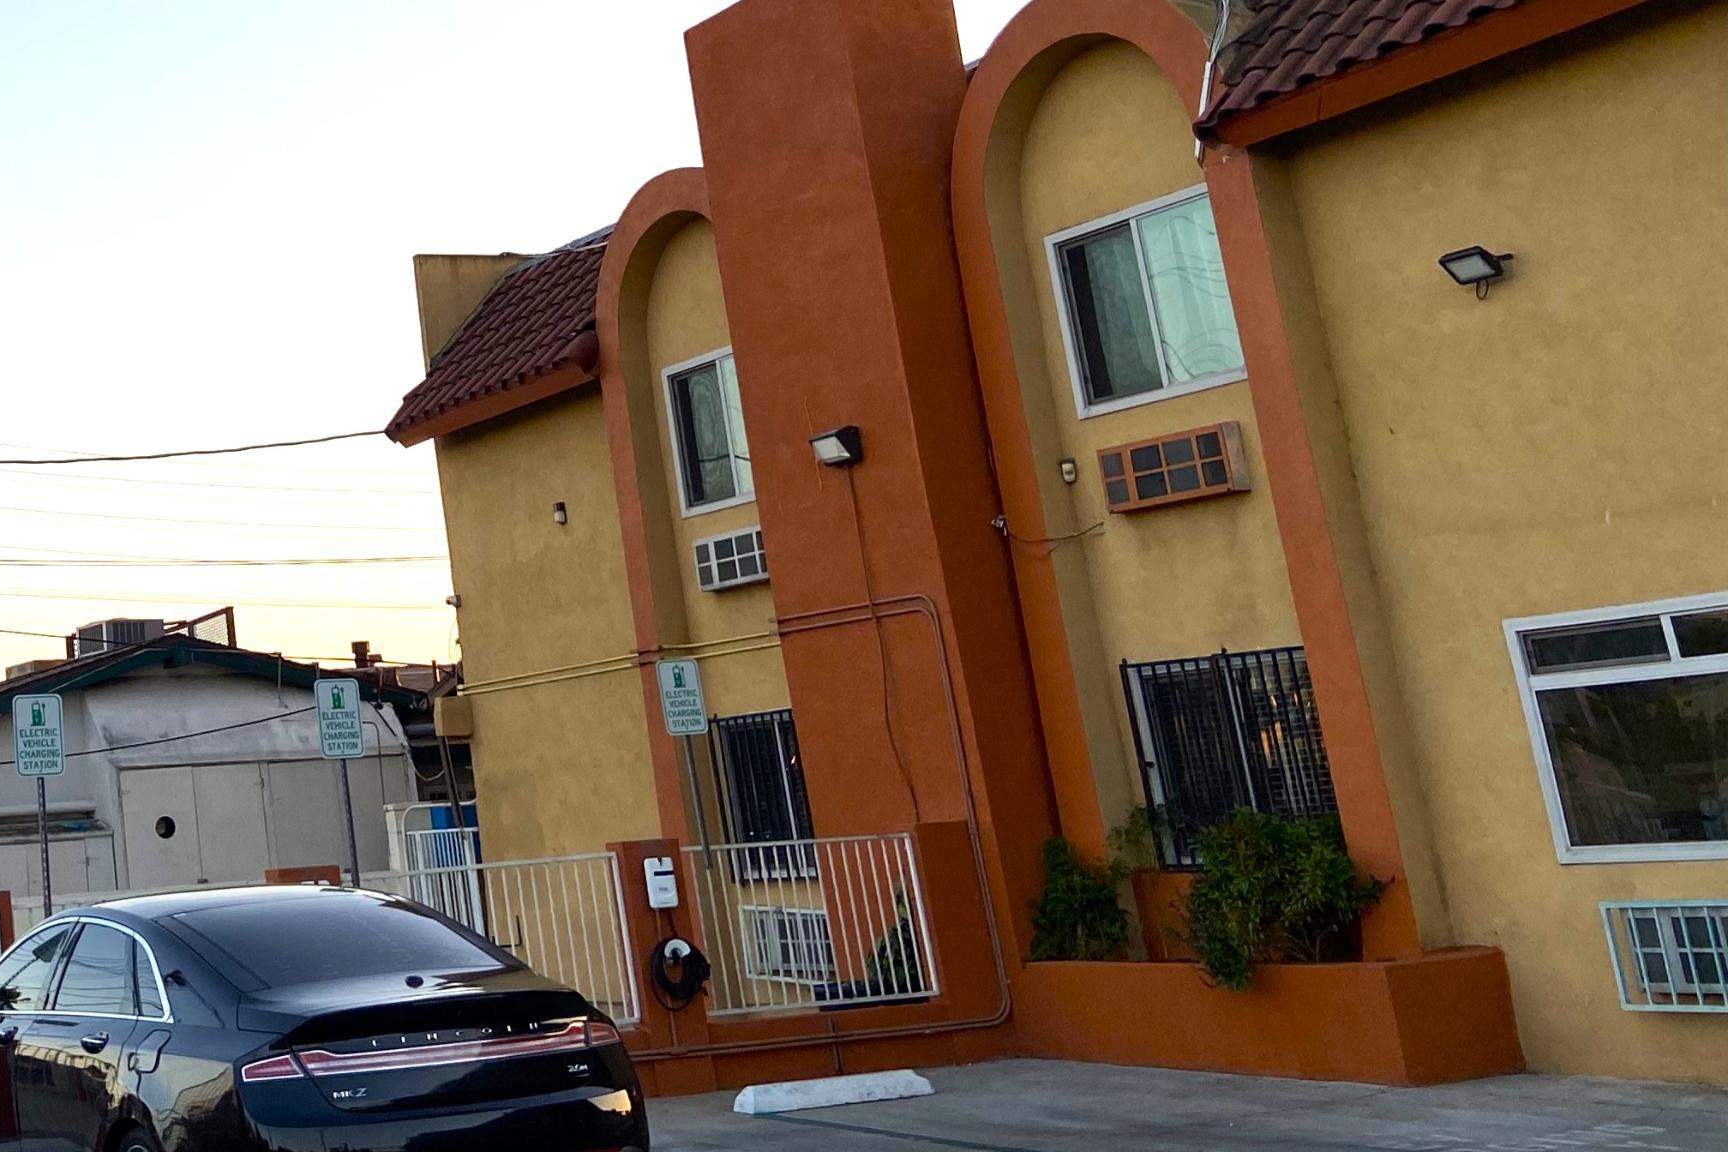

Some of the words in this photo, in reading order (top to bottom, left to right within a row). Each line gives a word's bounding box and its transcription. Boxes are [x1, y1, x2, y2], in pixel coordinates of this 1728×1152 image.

[665, 689, 698, 698] ELECTRIC
[670, 699, 698, 708] VEHICLE
[322, 711, 356, 720] ELECTRIC
[668, 709, 702, 718] CHARGING
[325, 721, 354, 730] VEHICLE
[672, 719, 702, 728] STATION
[19, 728, 59, 737] ELECTRIC
[324, 731, 359, 740] CHARGING
[23, 738, 57, 748] VEHICLE
[328, 742, 358, 751] STATION
[19, 749, 60, 759] CHARGING
[23, 760, 58, 770] STATION
